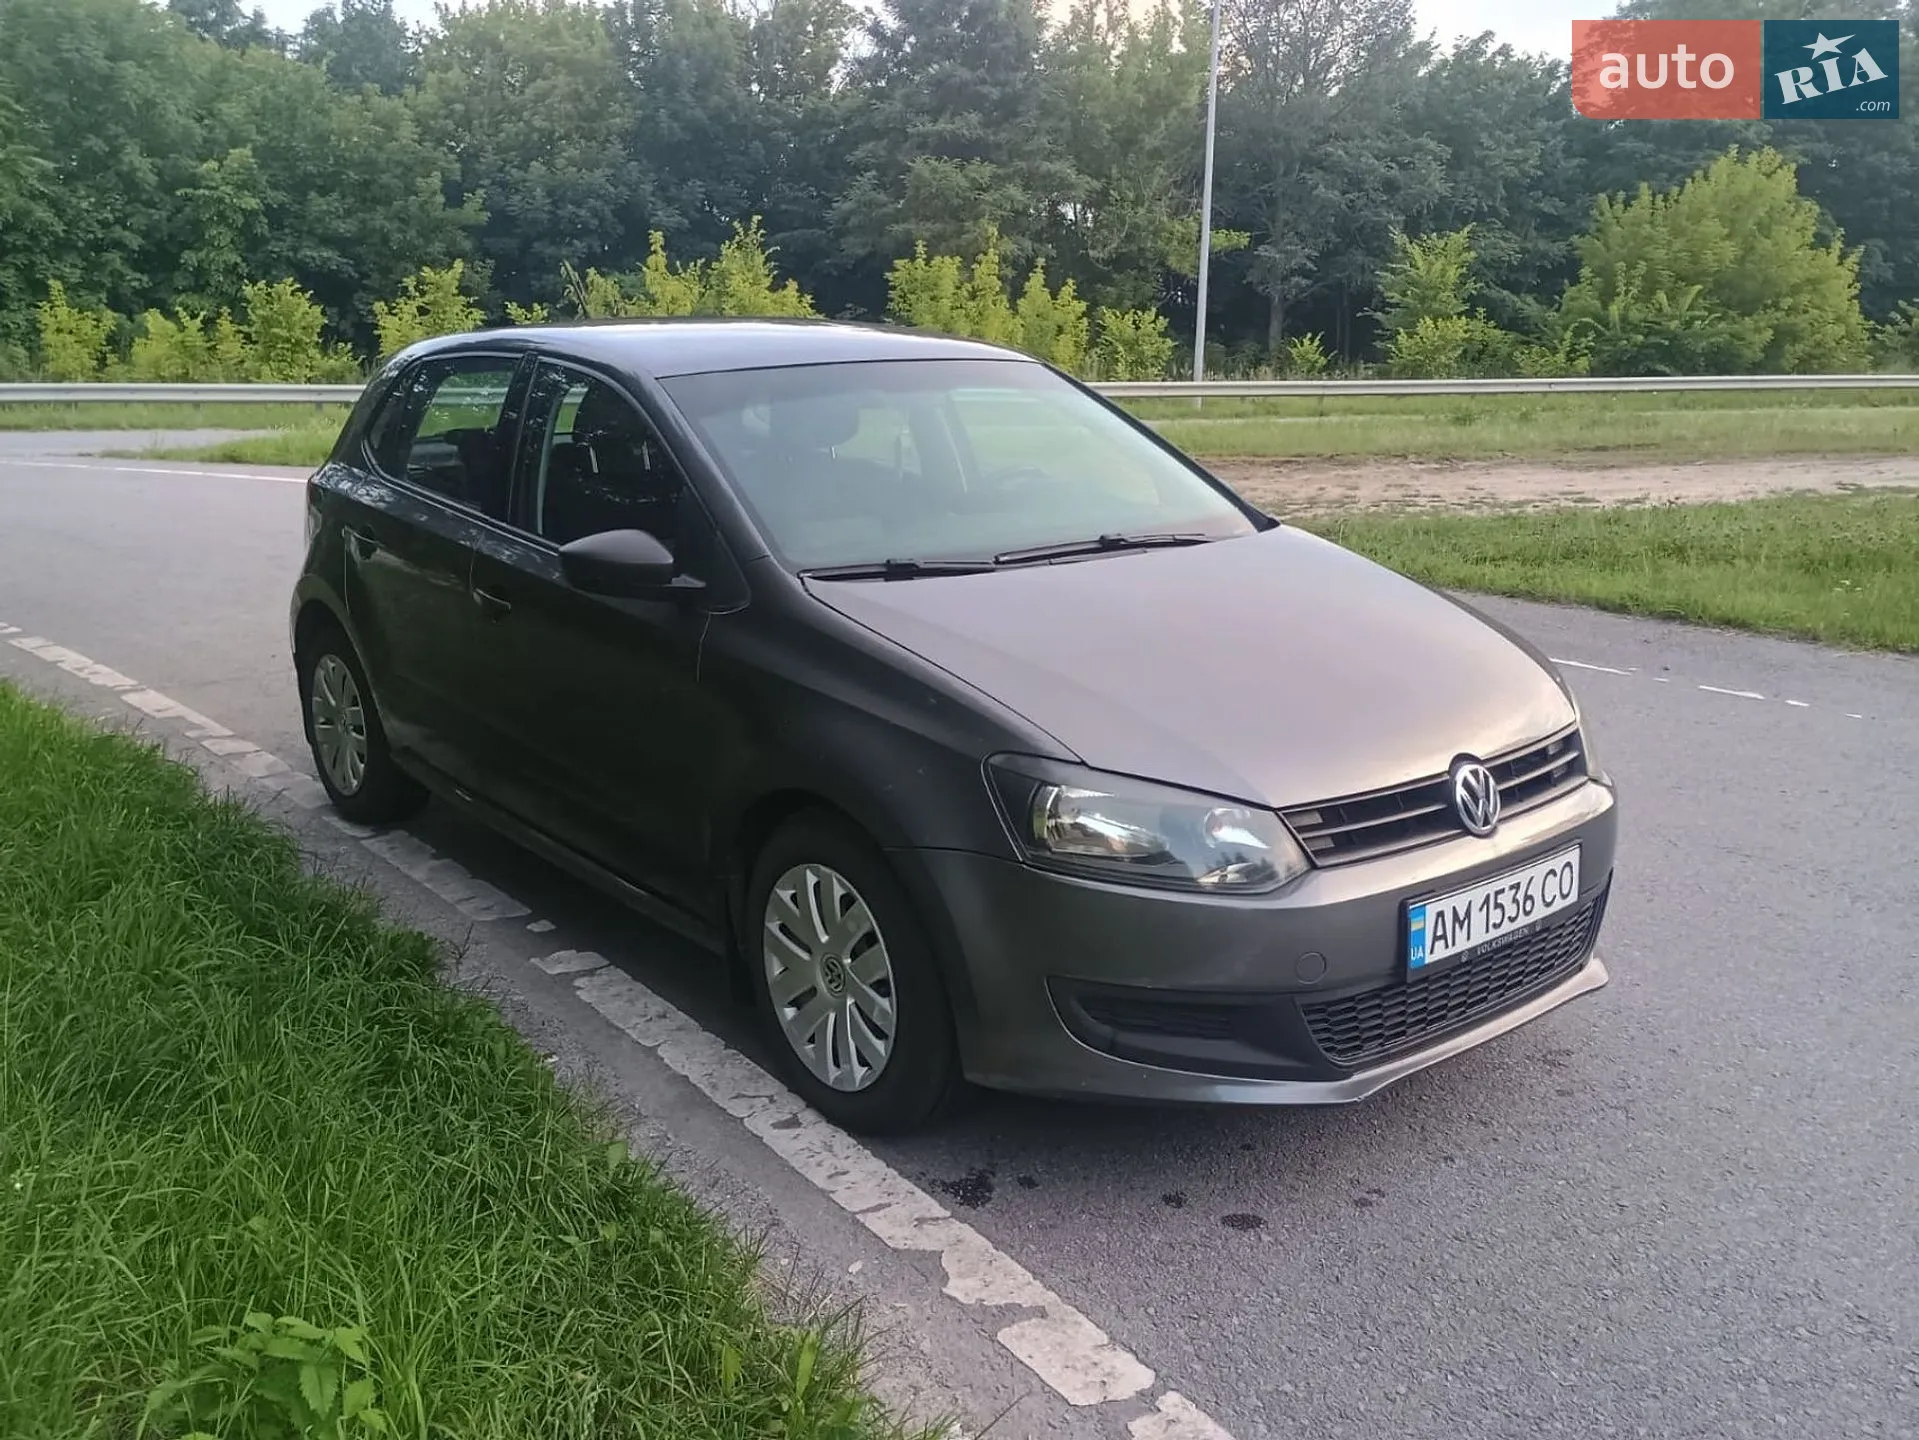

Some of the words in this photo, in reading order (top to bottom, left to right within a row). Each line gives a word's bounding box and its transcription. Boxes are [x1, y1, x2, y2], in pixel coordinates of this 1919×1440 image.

[1429, 900, 1472, 955] AM
[1478, 876, 1536, 934] 1536
[1541, 861, 1574, 908] CO
[1411, 947, 1425, 961] UA
